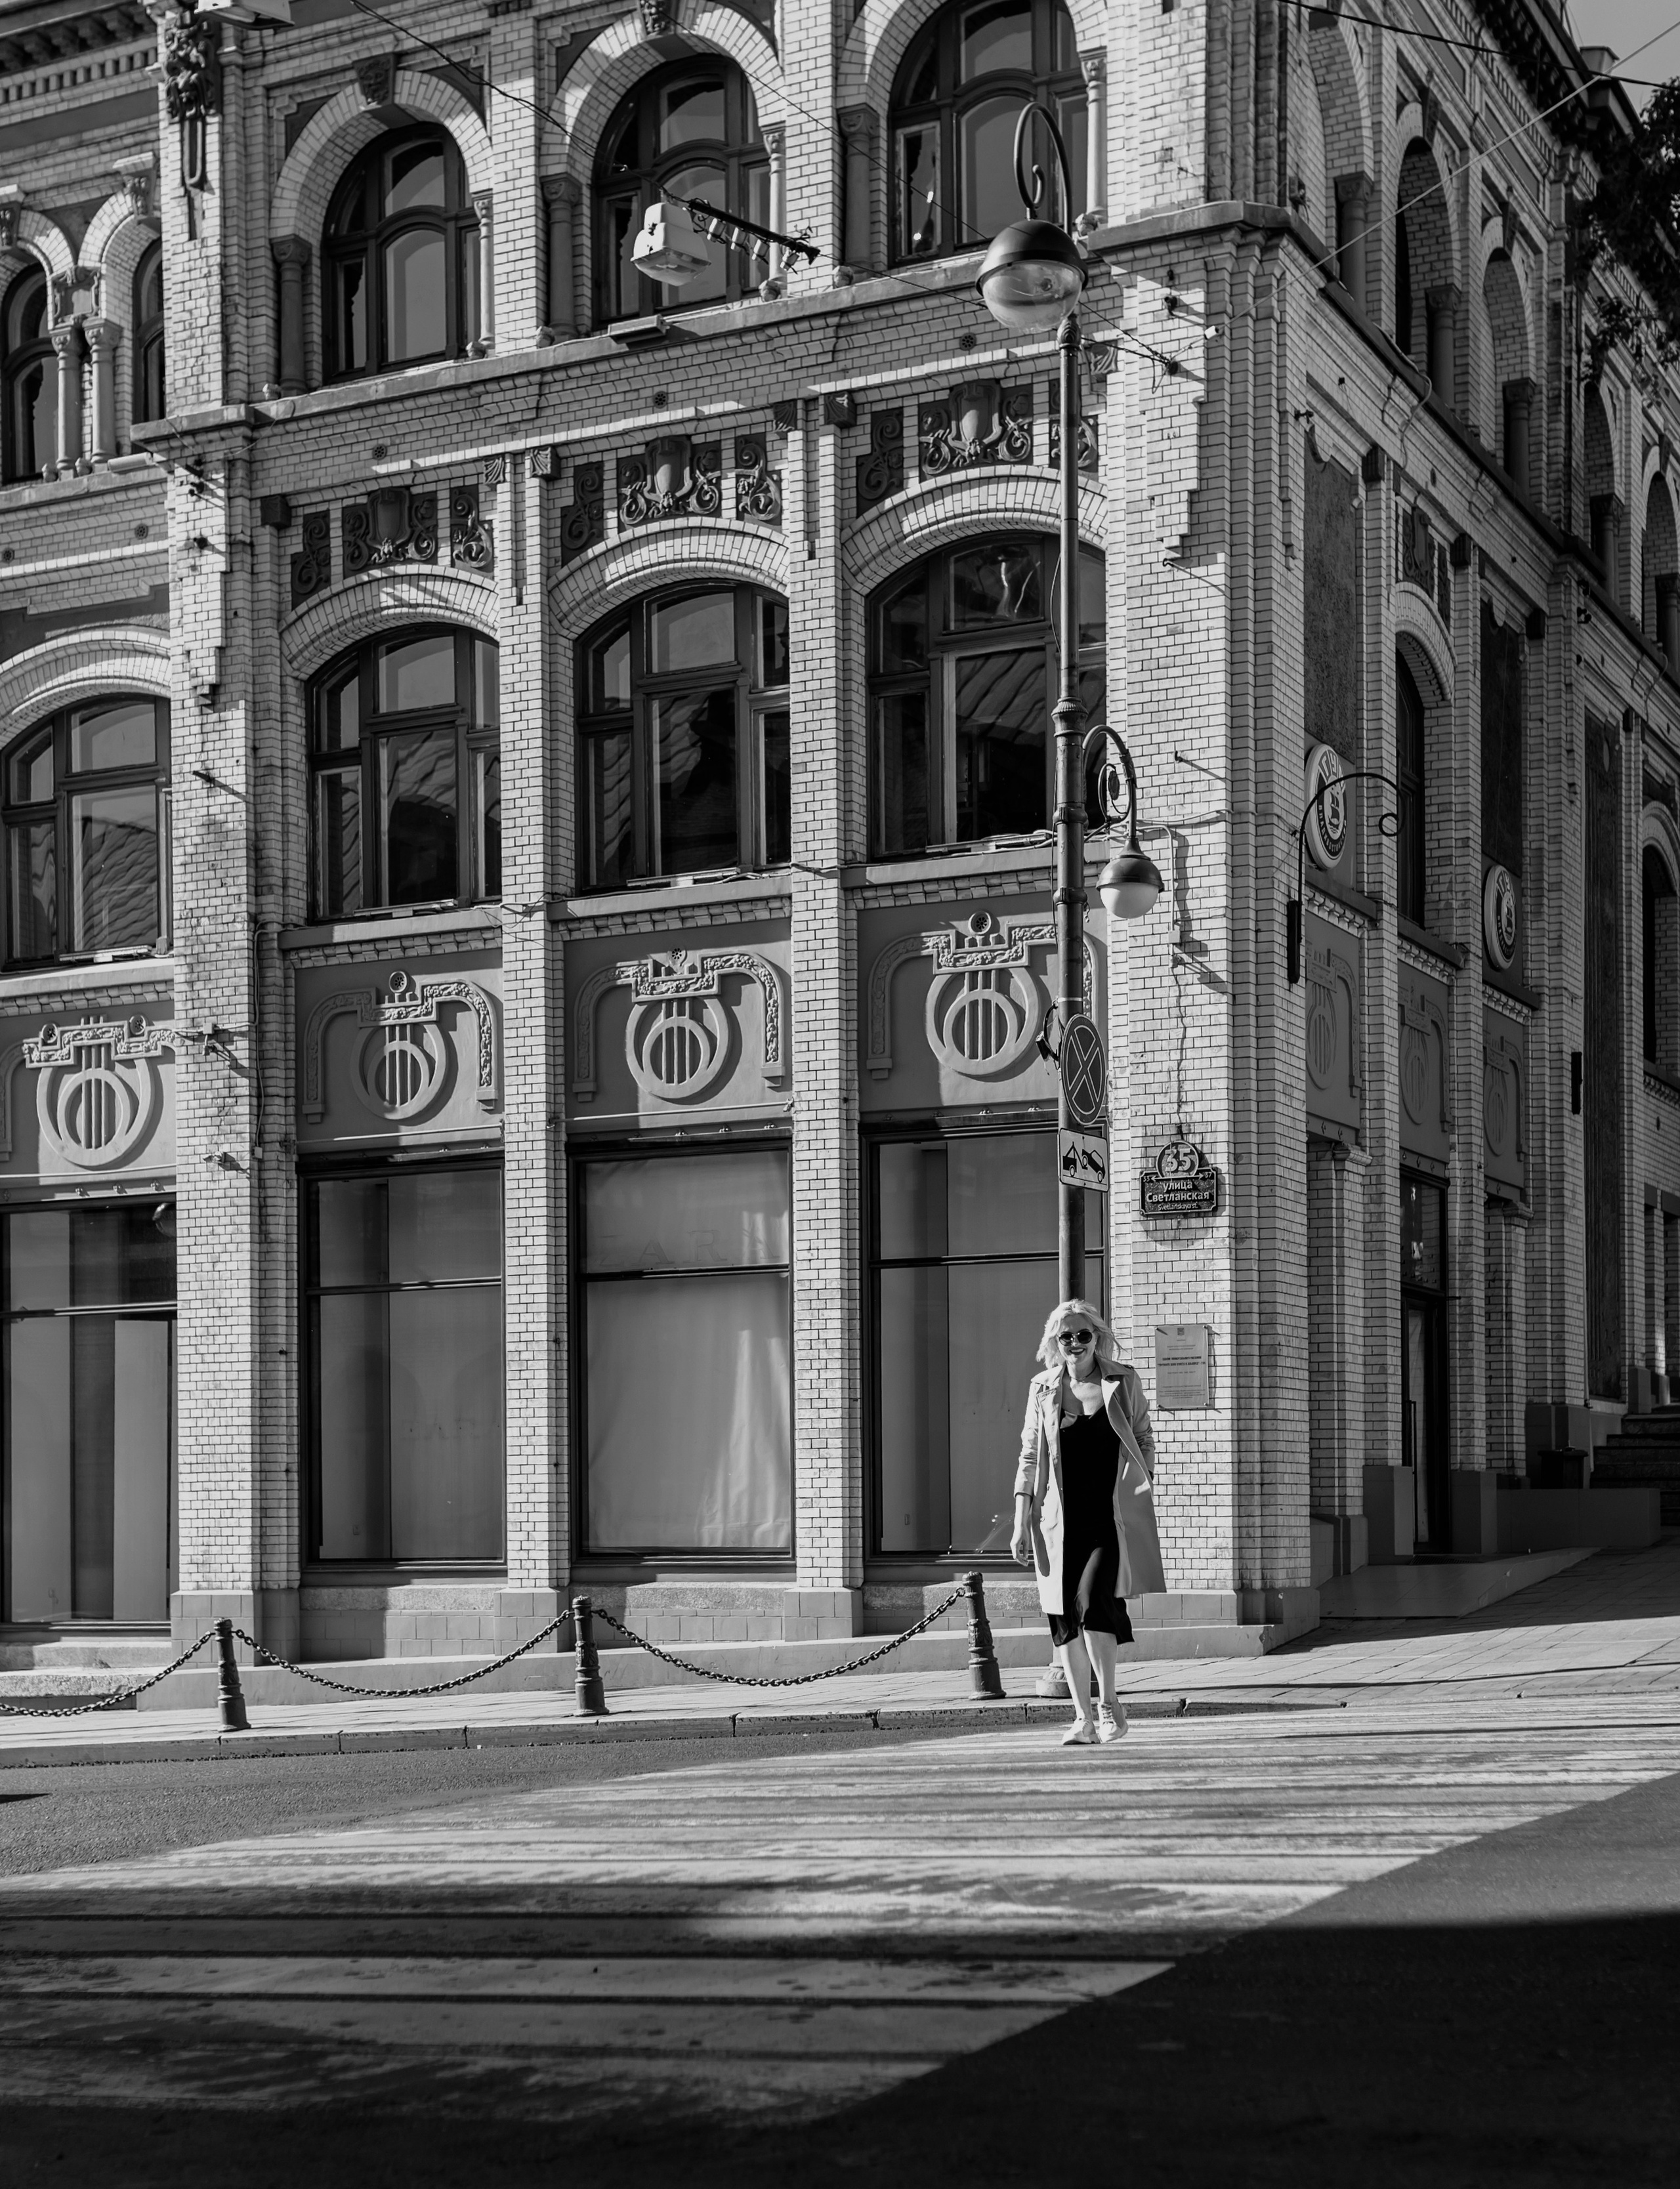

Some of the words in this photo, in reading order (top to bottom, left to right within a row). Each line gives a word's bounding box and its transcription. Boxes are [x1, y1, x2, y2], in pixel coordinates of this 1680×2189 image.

[1165, 1148, 1191, 1172] 35
[1163, 1181, 1193, 1192] улица
[1146, 1192, 1209, 1202] Светланская
[598, 1224, 781, 1267] ZARA
